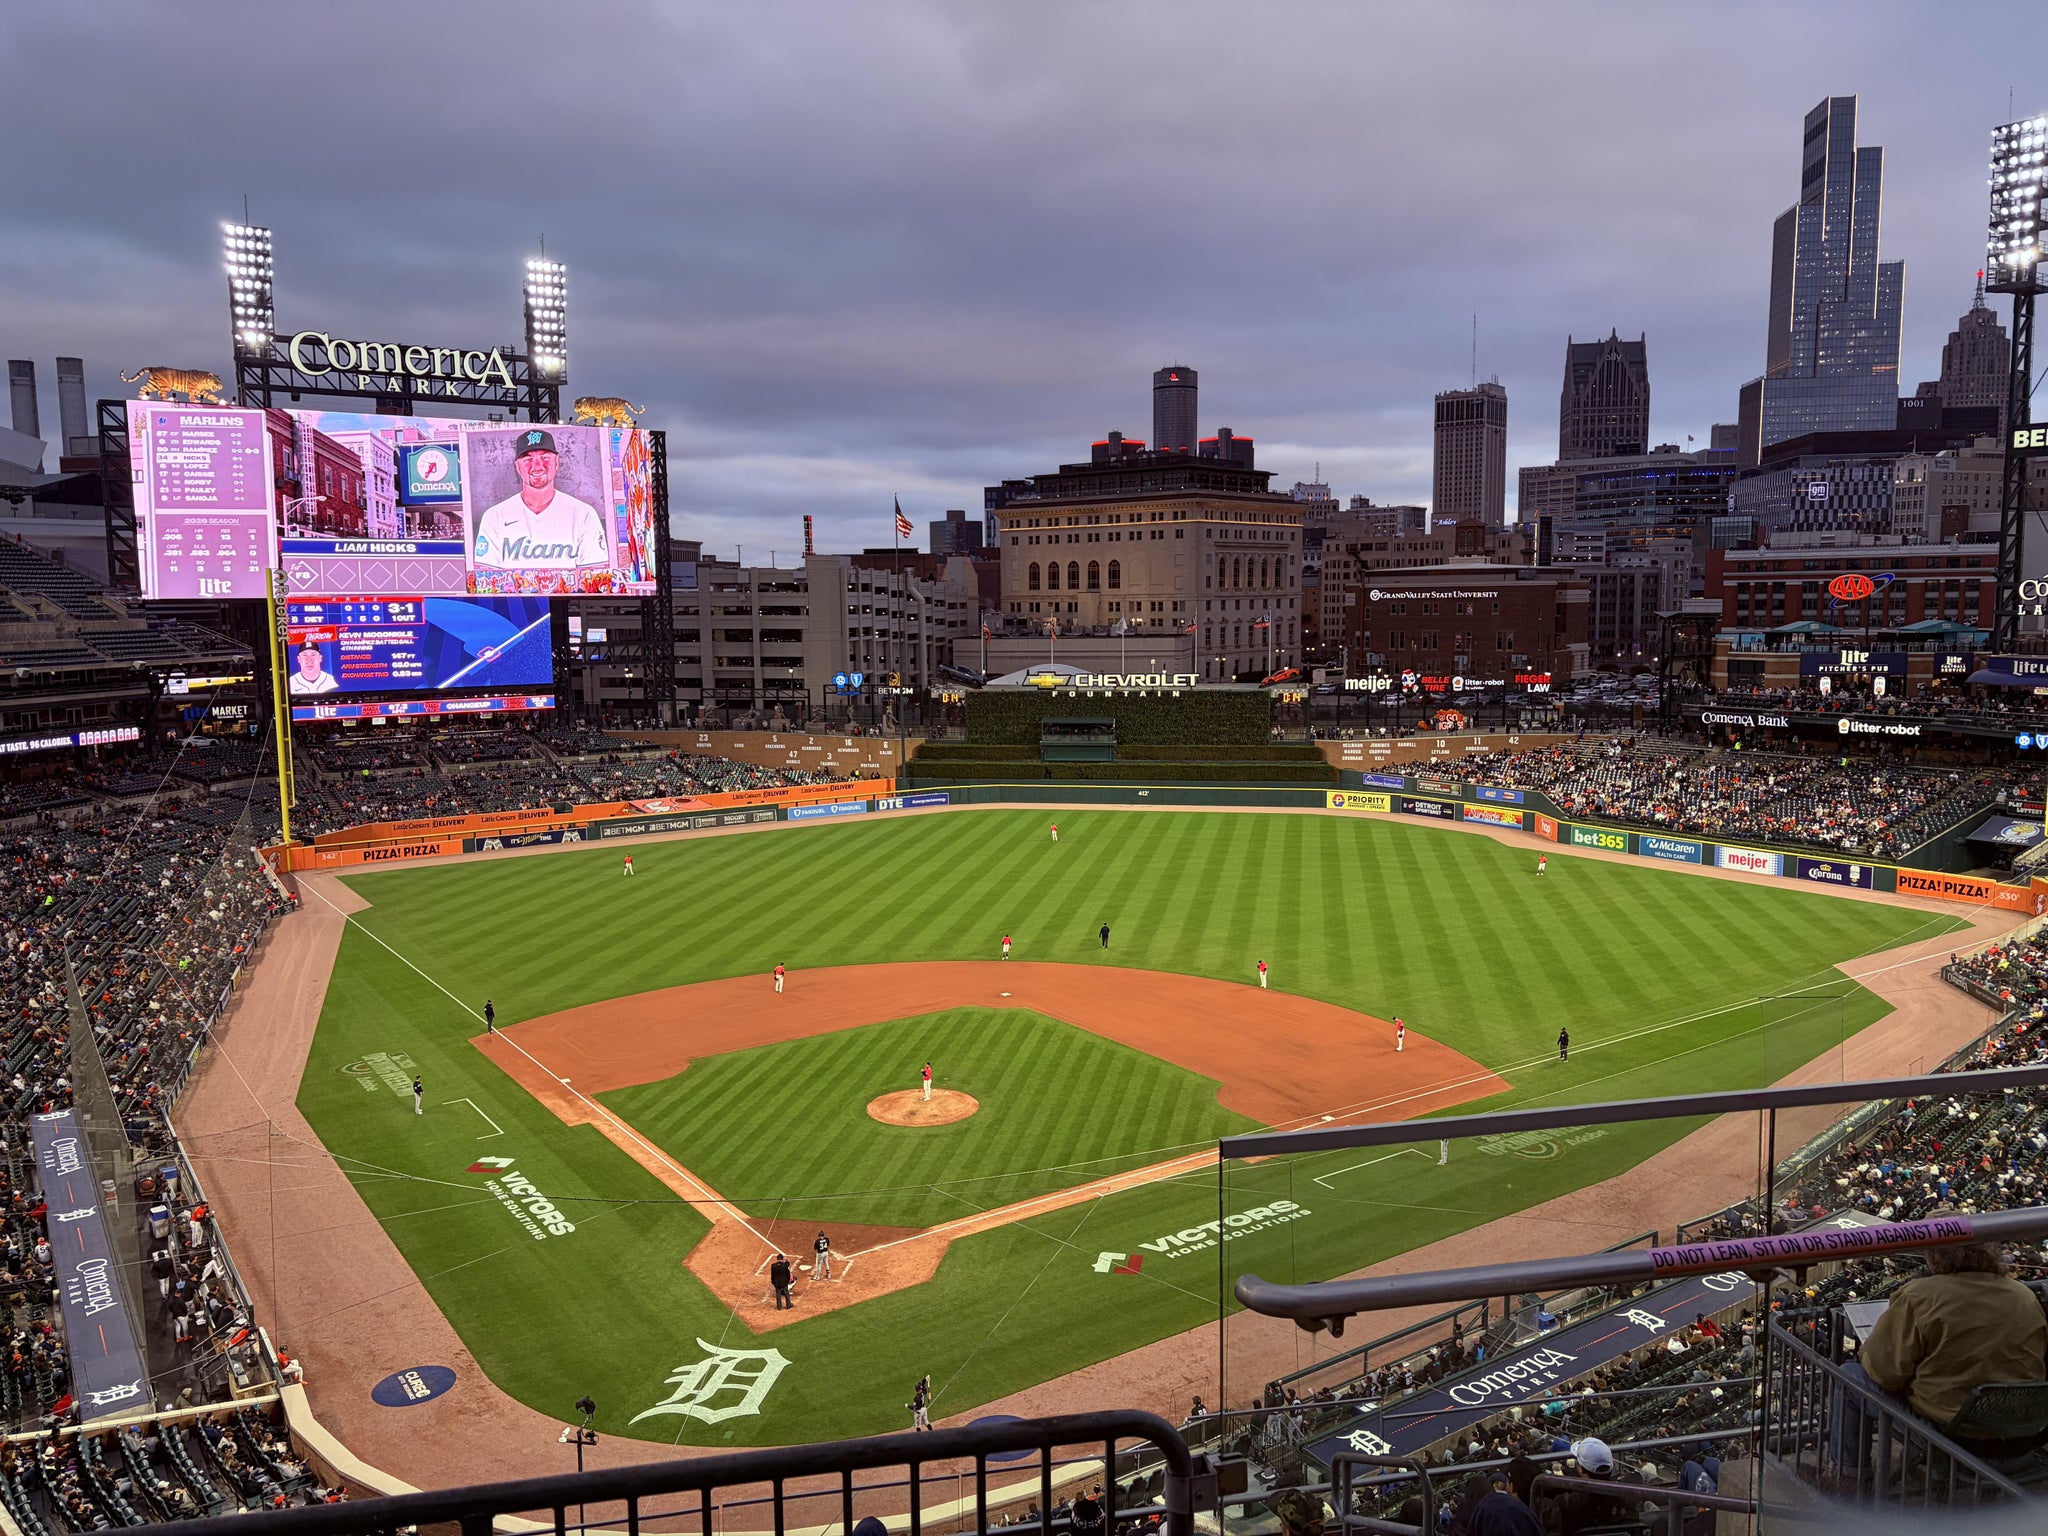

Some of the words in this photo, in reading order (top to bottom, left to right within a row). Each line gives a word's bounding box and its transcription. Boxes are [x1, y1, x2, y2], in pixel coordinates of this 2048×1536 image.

[358, 374, 460, 397] PARK
[1902, 399, 1924, 408] 1001
[180, 415, 244, 427] MARLINS
[1811, 485, 1827, 497] gm
[335, 543, 367, 552] LIAM
[370, 543, 417, 553] HICKS
[198, 578, 232, 598] Lite
[1833, 577, 1870, 597] AAA
[1380, 591, 1405, 600] GRAND
[1404, 591, 1431, 599] VALLEY
[1431, 591, 1453, 599] STATE
[1453, 590, 1498, 599] UNIVERSITY
[388, 603, 414, 614] 3-1
[304, 633, 333, 642] THROW
[1841, 650, 1870, 666] Lite
[1946, 656, 1962, 665] Lite
[2013, 660, 2038, 676] Lite
[1075, 673, 1200, 688] CHEVROLET
[1344, 674, 1393, 694] meijer
[1421, 676, 1450, 684] BELLE
[1515, 674, 1551, 684] FIEGER
[1052, 690, 1181, 698] FOUNTAIN
[1425, 684, 1446, 692] TIRE
[1527, 683, 1551, 693] LAW
[211, 705, 248, 717] MARKET
[315, 706, 337, 718] Lite
[446, 701, 491, 710] CHANGEUP
[1757, 715, 1789, 728] Bank
[6, 742, 29, 752] TASTE.
[30, 741, 39, 749] 96
[40, 736, 73, 748] CALORIES.
[808, 737, 814, 745] 2
[844, 738, 853, 746] 16
[1436, 739, 1445, 748] 10
[1473, 737, 1481, 745] 11
[1508, 736, 1519, 745] 42
[789, 750, 798, 758] 47
[868, 754, 872, 762] 1
[762, 789, 790, 798] DELIVERY
[829, 783, 855, 792] DELIVERY
[879, 799, 903, 810] DTE
[1347, 795, 1386, 806] PRIORITY
[1415, 801, 1442, 811] DETROIT
[838, 804, 862, 812] FANDUEL
[496, 814, 516, 822] Caesars
[518, 811, 550, 821] DELIVERY
[1468, 809, 1501, 823] Surfside
[432, 818, 466, 828] DELIVERY
[611, 825, 645, 836] BETMGM
[656, 820, 689, 831] BETMGM
[1574, 829, 1624, 849] bet365
[363, 847, 402, 862] PIZZA!
[404, 844, 441, 858] PIZZA!
[1659, 840, 1695, 854] McLaren
[321, 851, 338, 861] 342'
[1654, 851, 1671, 859] HEALTH
[1672, 853, 1686, 861] CARE
[1728, 852, 1768, 870] meijer
[1808, 867, 1842, 881] Corona
[1900, 876, 1941, 892] PIZZA!
[1944, 882, 1989, 899] PIZZA!
[42, 1150, 53, 1169] PARK
[500, 1170, 576, 1236] VICTORS
[483, 1179, 508, 1201] HOME
[502, 1197, 547, 1241] SOLUTIONS
[1138, 1200, 1300, 1252] VICTORS
[1166, 1238, 1218, 1259] HOME
[1222, 1209, 1312, 1241] SOLUTIONS
[1653, 1250, 1675, 1267] DO
[1679, 1247, 1706, 1265] NOT
[1709, 1243, 1752, 1262] LEAN,
[1755, 1240, 1777, 1256] SIT
[1781, 1238, 1801, 1254] ON
[1804, 1236, 1825, 1252] OR
[1828, 1230, 1873, 1249] STAND
[1877, 1224, 1934, 1244] AGAINST
[66, 1277, 82, 1305] PARK
[1500, 1369, 1558, 1400] PARK
